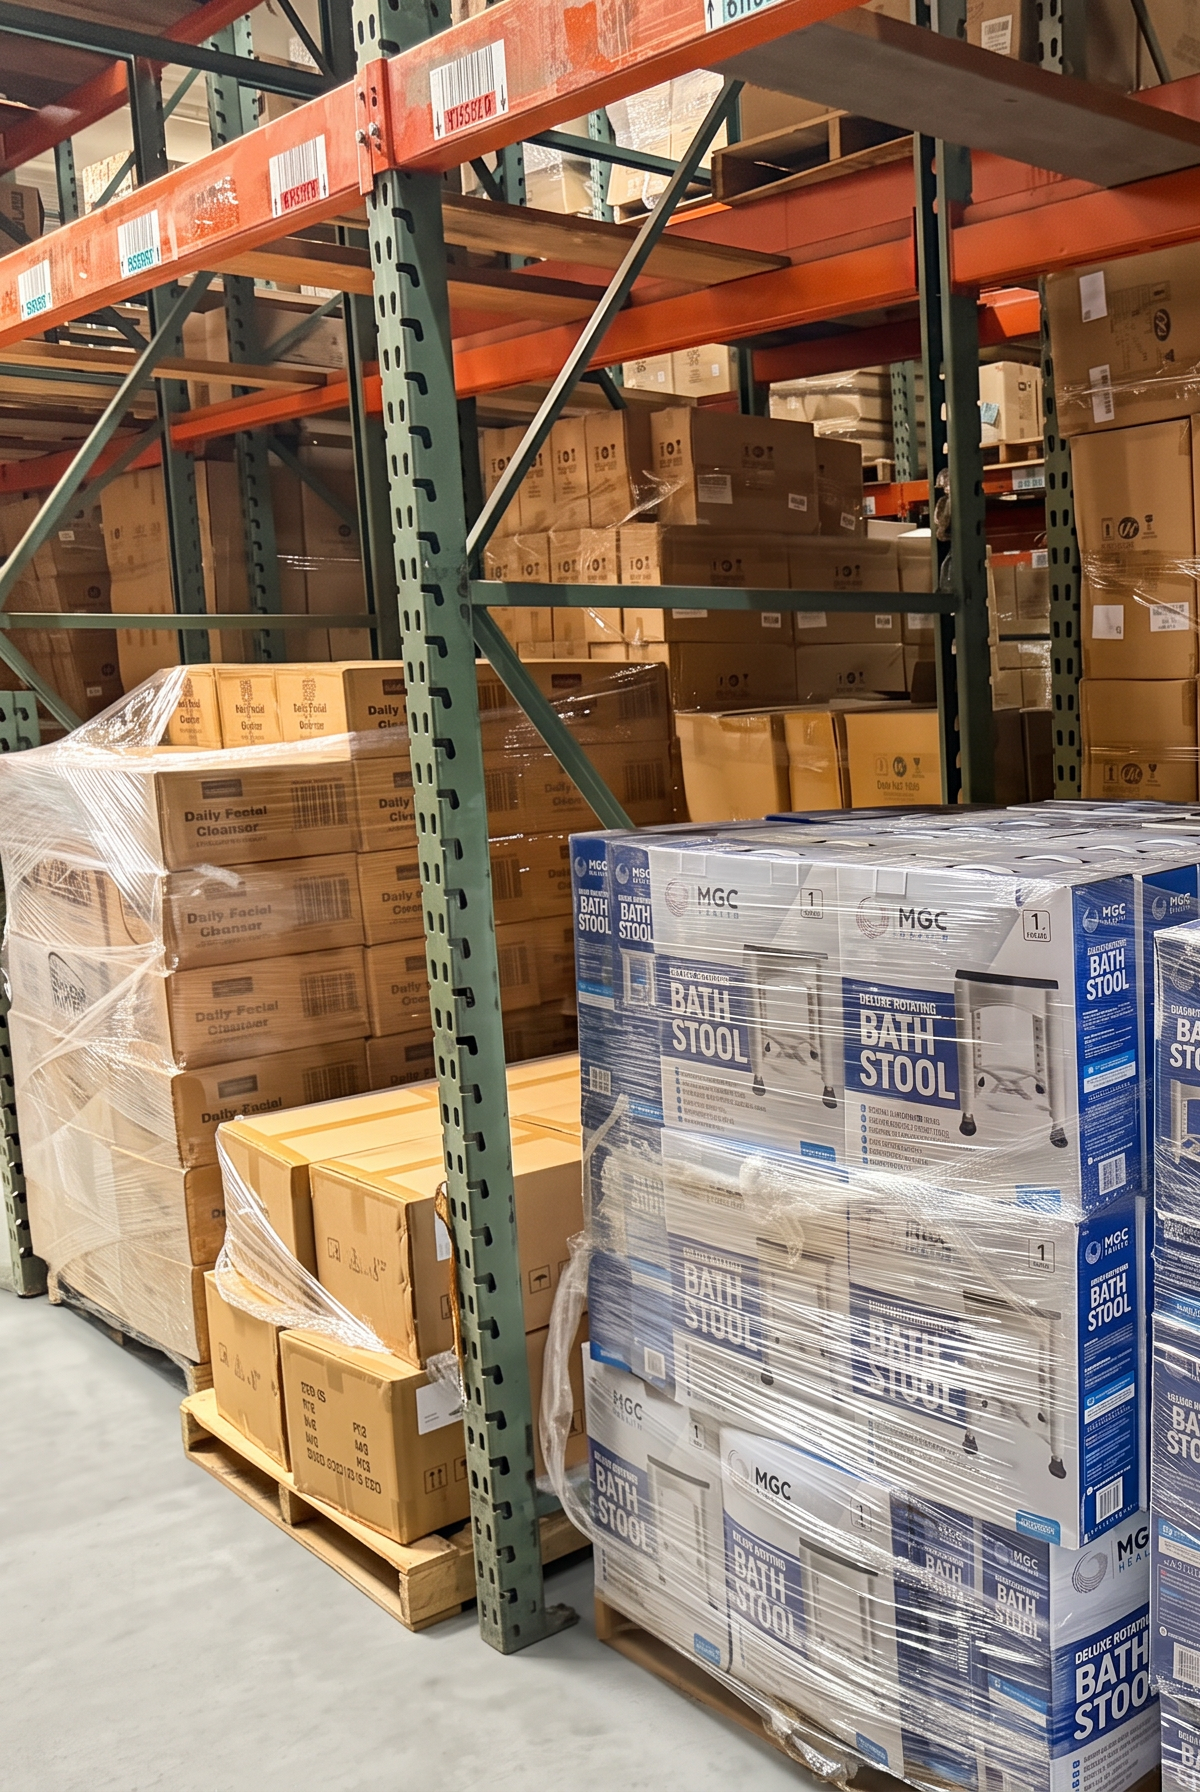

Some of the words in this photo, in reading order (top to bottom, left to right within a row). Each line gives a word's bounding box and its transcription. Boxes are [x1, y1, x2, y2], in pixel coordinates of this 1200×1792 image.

[185, 808, 221, 822] Daily
[580, 896, 609, 916] BATH
[620, 902, 650, 924] BATH
[697, 886, 739, 910] MGC
[807, 891, 814, 906] 1
[1102, 903, 1126, 918] MGC
[579, 914, 611, 935] STOOL
[899, 907, 948, 931] MGC
[1089, 948, 1125, 978] BATH
[669, 981, 730, 1022] BATH
[1086, 971, 1130, 1001] STOOL
[859, 993, 891, 1009] DELUXE
[893, 998, 936, 1015] ROTATING
[672, 1018, 750, 1064] STOOL
[859, 1010, 934, 1056] BATH
[859, 1050, 956, 1100] STOOL
[683, 1261, 742, 1308] BATH
[1090, 1273, 1127, 1308] BATH
[1088, 1298, 1132, 1332] STOOL
[868, 1315, 942, 1361] BATH
[595, 1464, 639, 1515] BATH
[755, 1467, 792, 1501] MGC
[597, 1496, 656, 1555] STOOL
[1014, 1551, 1038, 1570] MGC
[1117, 1526, 1149, 1562] MG
[733, 1543, 786, 1604] BATH
[925, 1554, 962, 1584] BATH
[1119, 1551, 1150, 1573] HEAL
[997, 1583, 1036, 1618] BATH
[1076, 1638, 1112, 1664] DELUXE
[1113, 1614, 1149, 1648] ROTATI
[1075, 1631, 1149, 1704] BATH
[1073, 1669, 1149, 1741] STOO
